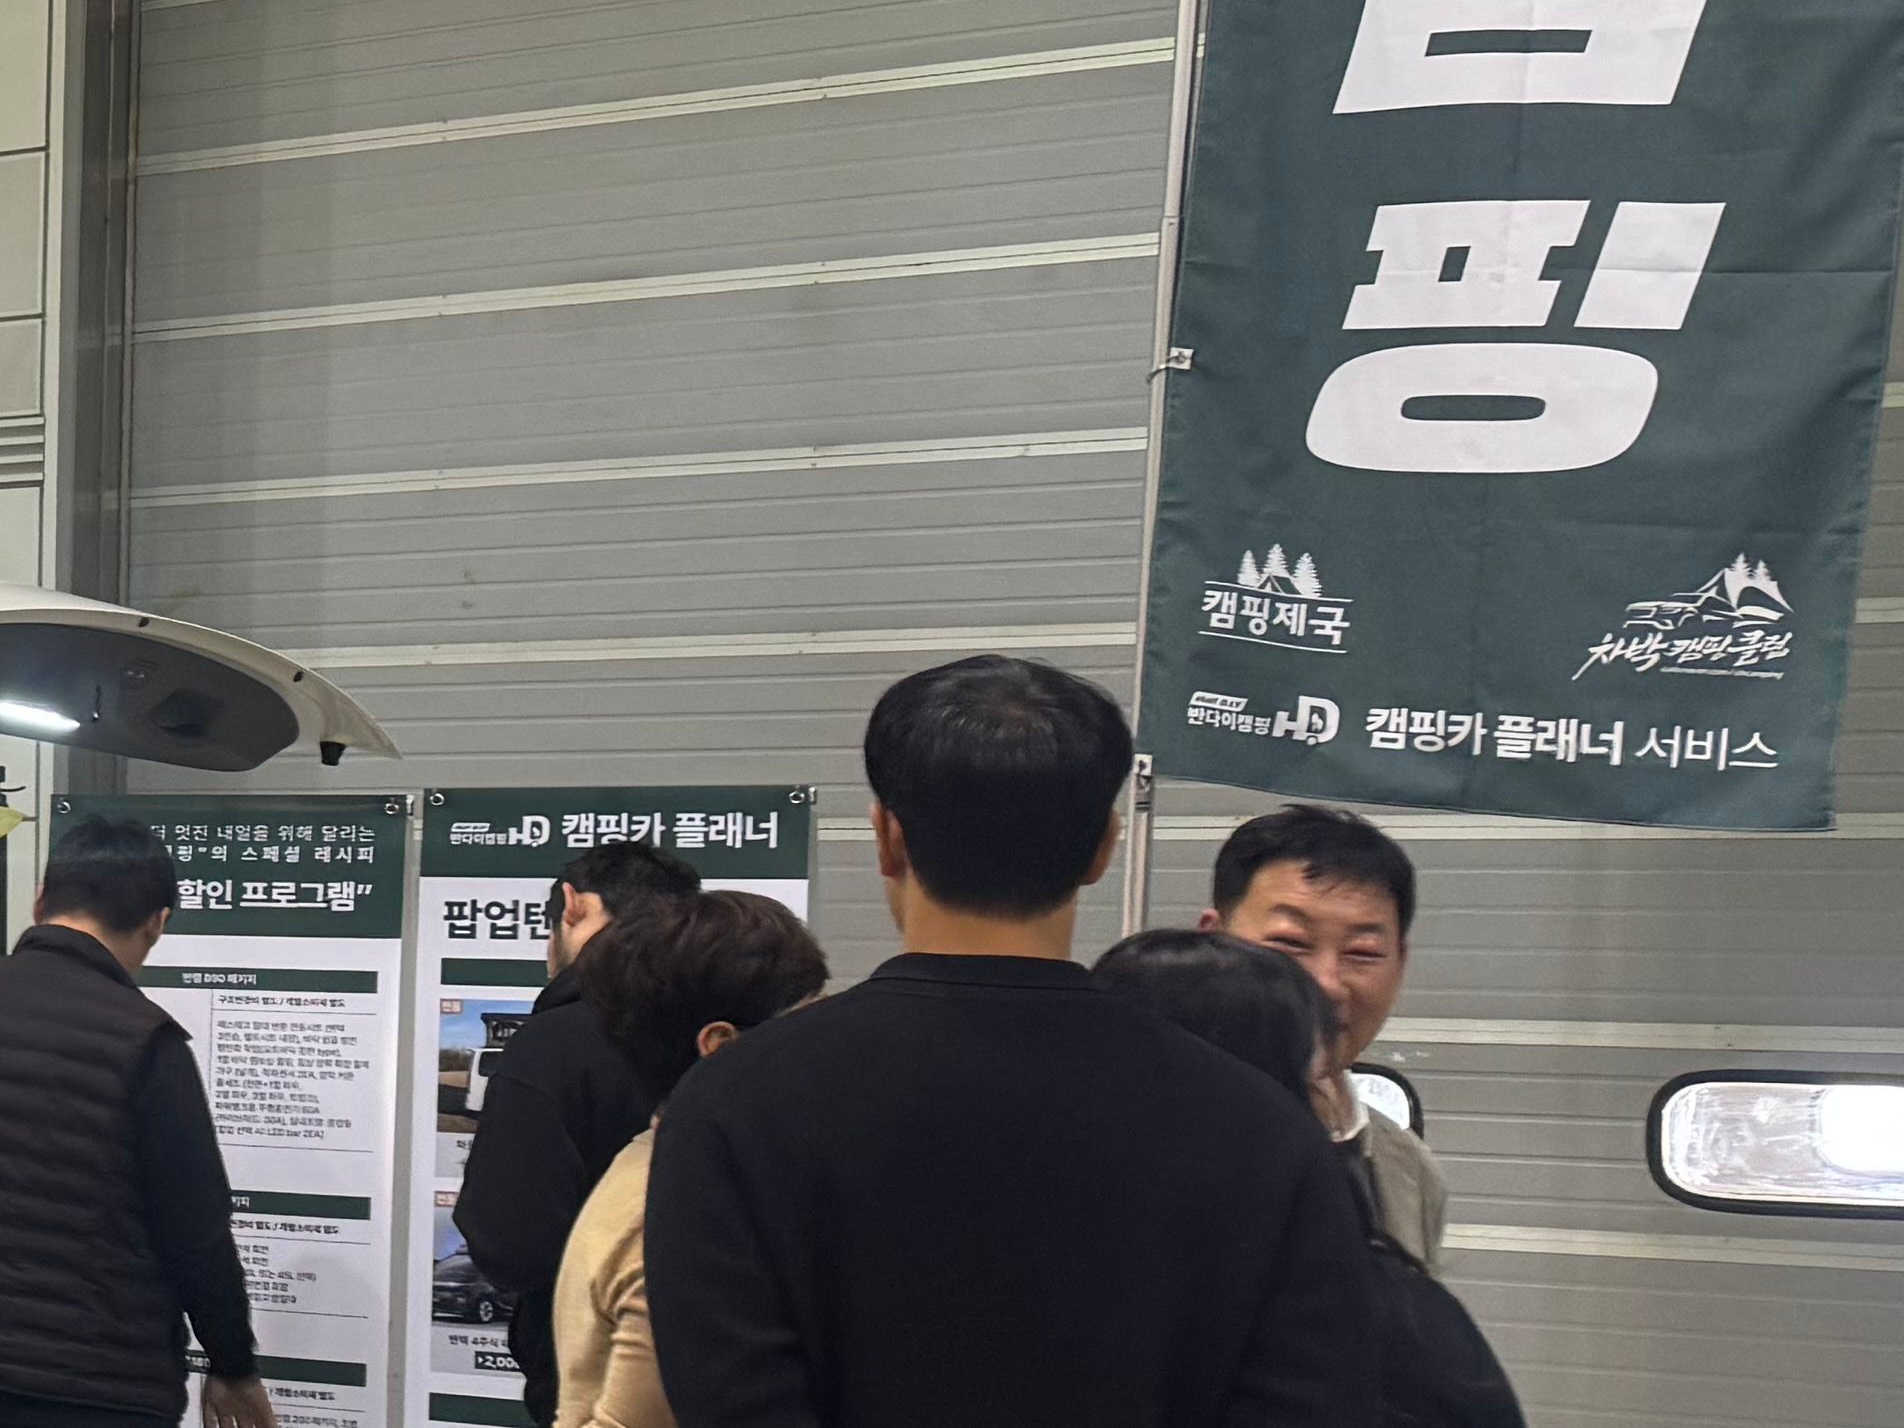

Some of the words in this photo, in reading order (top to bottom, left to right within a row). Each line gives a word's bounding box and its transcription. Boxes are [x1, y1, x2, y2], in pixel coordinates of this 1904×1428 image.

[1201, 589, 1351, 645] 캠핑제국
[1187, 706, 1272, 736] 반다이캠핑
[1365, 707, 1488, 756] 캠핑카
[1493, 713, 1624, 767] 플래너
[1634, 725, 1779, 772] 서비스
[175, 824, 209, 842] 멋진
[216, 824, 270, 842] 내일을
[277, 824, 314, 843] 위해
[321, 824, 376, 843] 달리는
[561, 811, 668, 849] 캠핑카
[672, 811, 779, 850] 플래너
[240, 845, 302, 864] 스페셜
[313, 845, 375, 865] 레시피
[176, 878, 234, 911] 할인
[443, 899, 550, 941] 팝업텐
